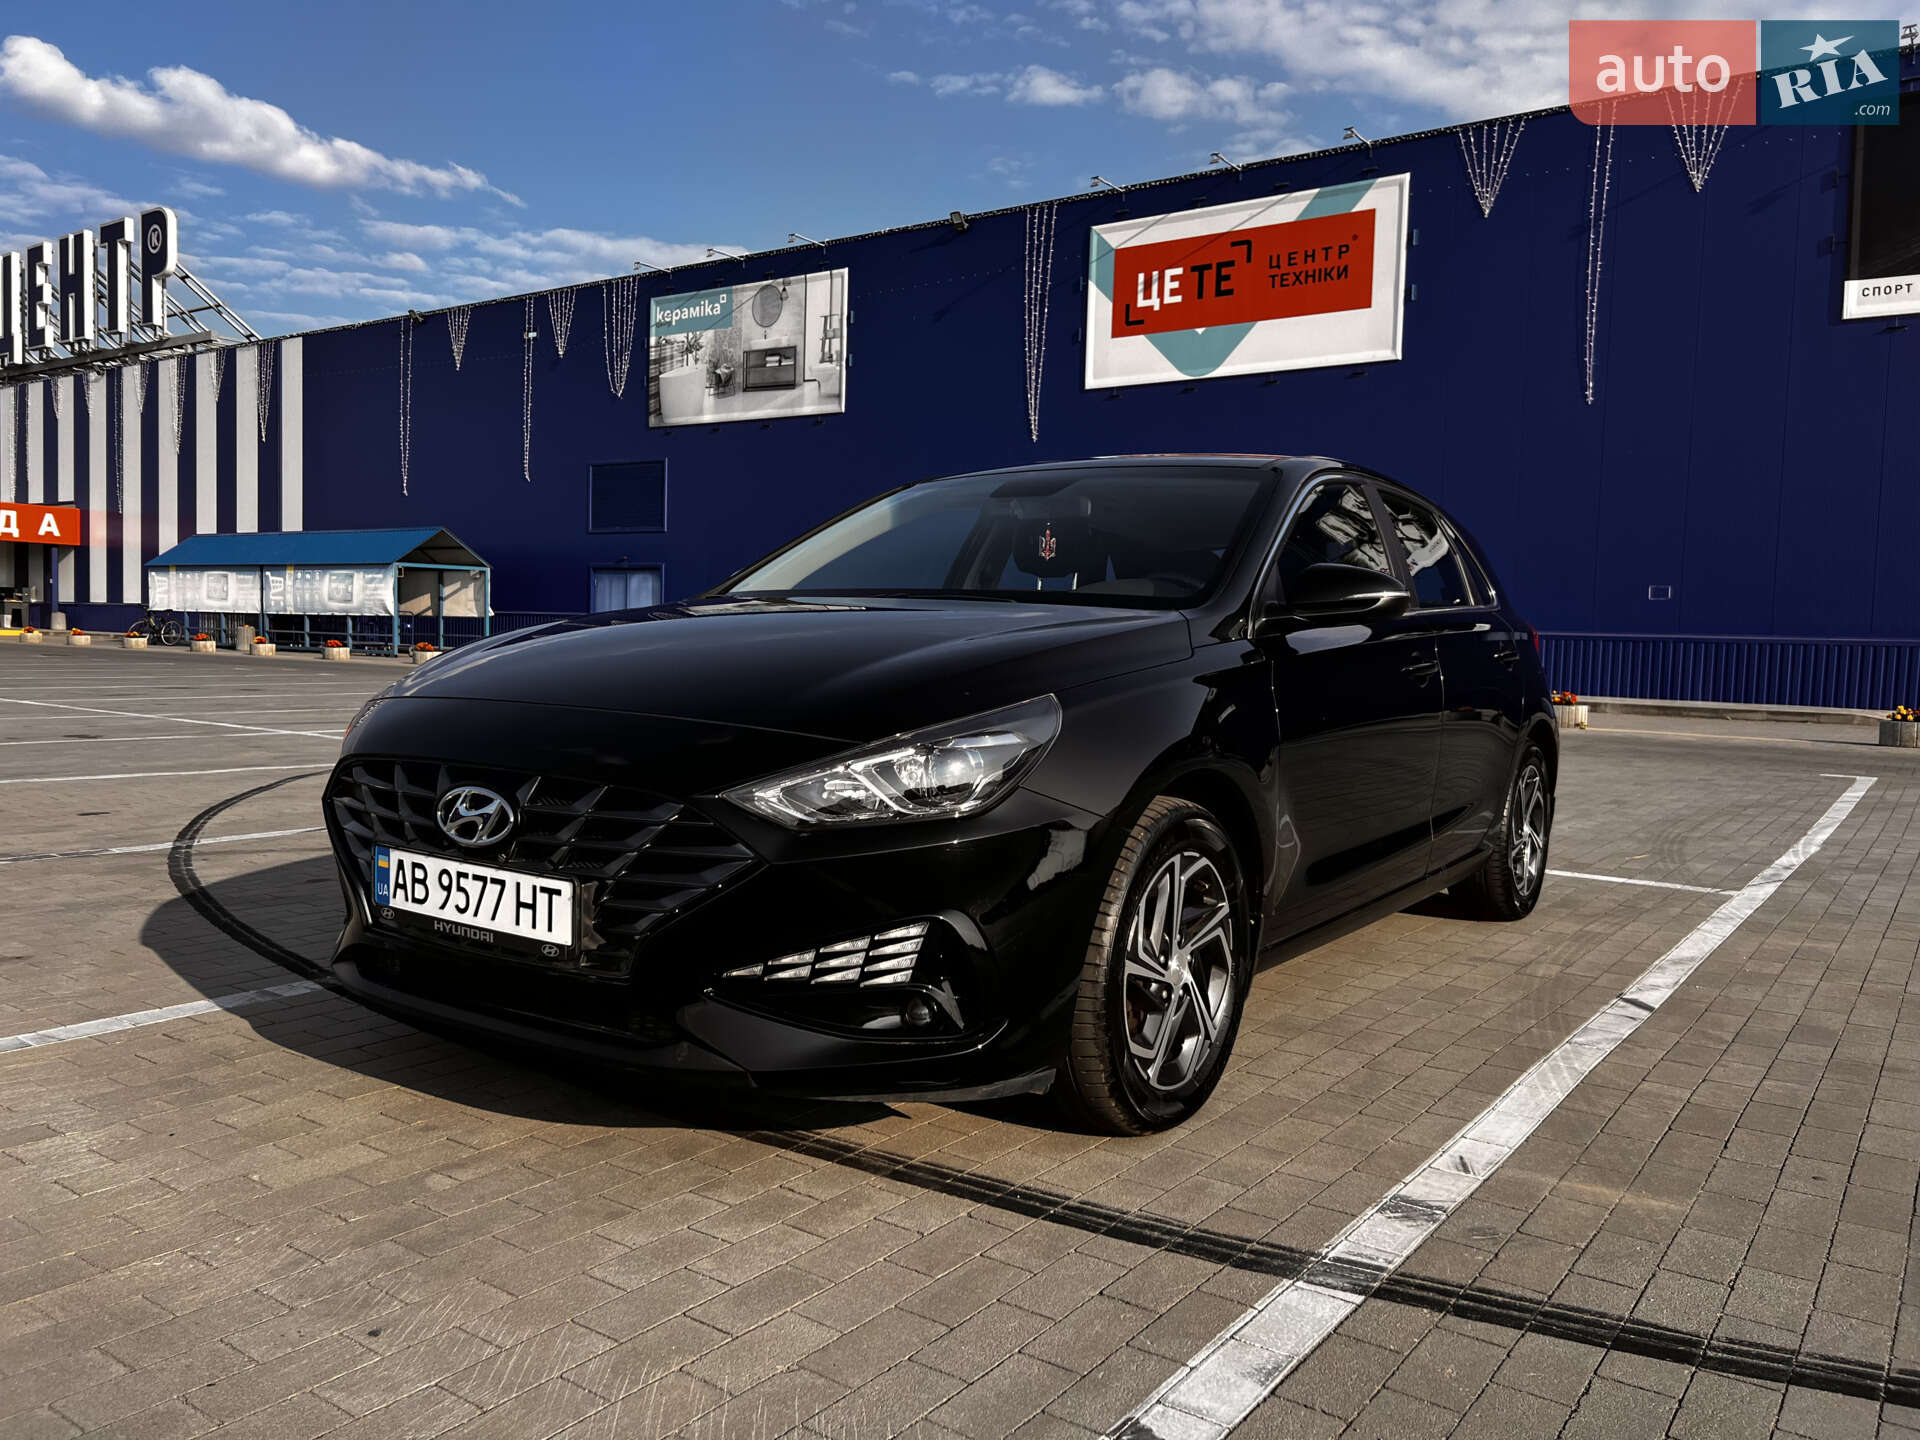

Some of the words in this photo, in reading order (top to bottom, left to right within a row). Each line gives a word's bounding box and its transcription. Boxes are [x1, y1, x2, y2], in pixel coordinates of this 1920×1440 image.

[1269, 244, 1350, 270] ЦЕНТР
[1268, 264, 1349, 288] ТЕХНІКИ
[1862, 283, 1913, 297] СПОРТ
[377, 882, 389, 897] UA
[392, 859, 430, 905] AB
[438, 869, 506, 922] 9577
[515, 881, 562, 933] HT
[434, 920, 494, 943] HYUNDAI
